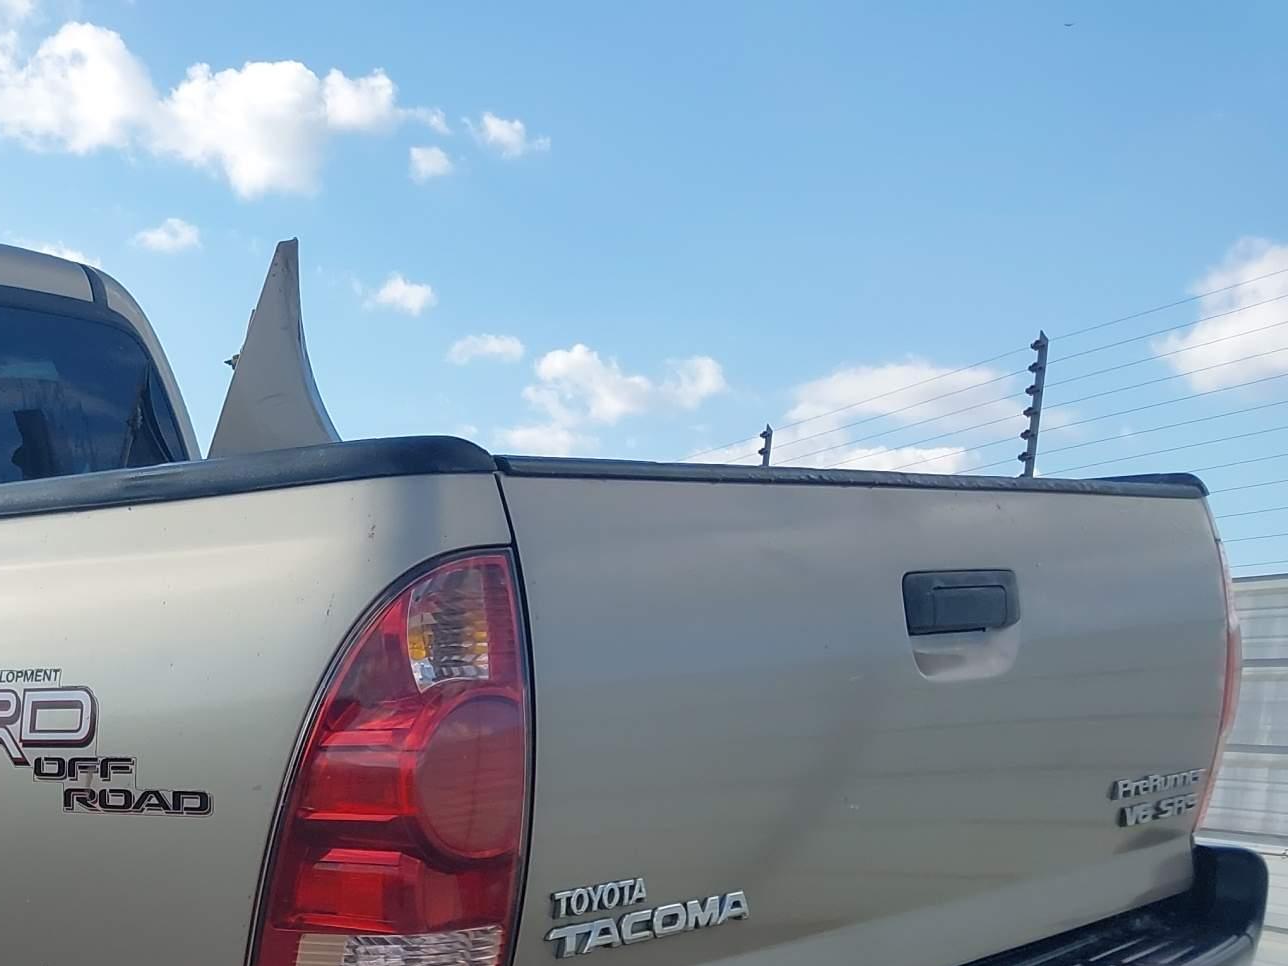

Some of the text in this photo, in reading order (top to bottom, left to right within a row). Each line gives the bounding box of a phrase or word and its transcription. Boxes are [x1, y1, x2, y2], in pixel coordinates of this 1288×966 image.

[33, 756, 134, 782] OFF
[62, 787, 212, 815] ROAD
[553, 878, 647, 919] TOYOTA
[544, 889, 750, 958] TACOMA
